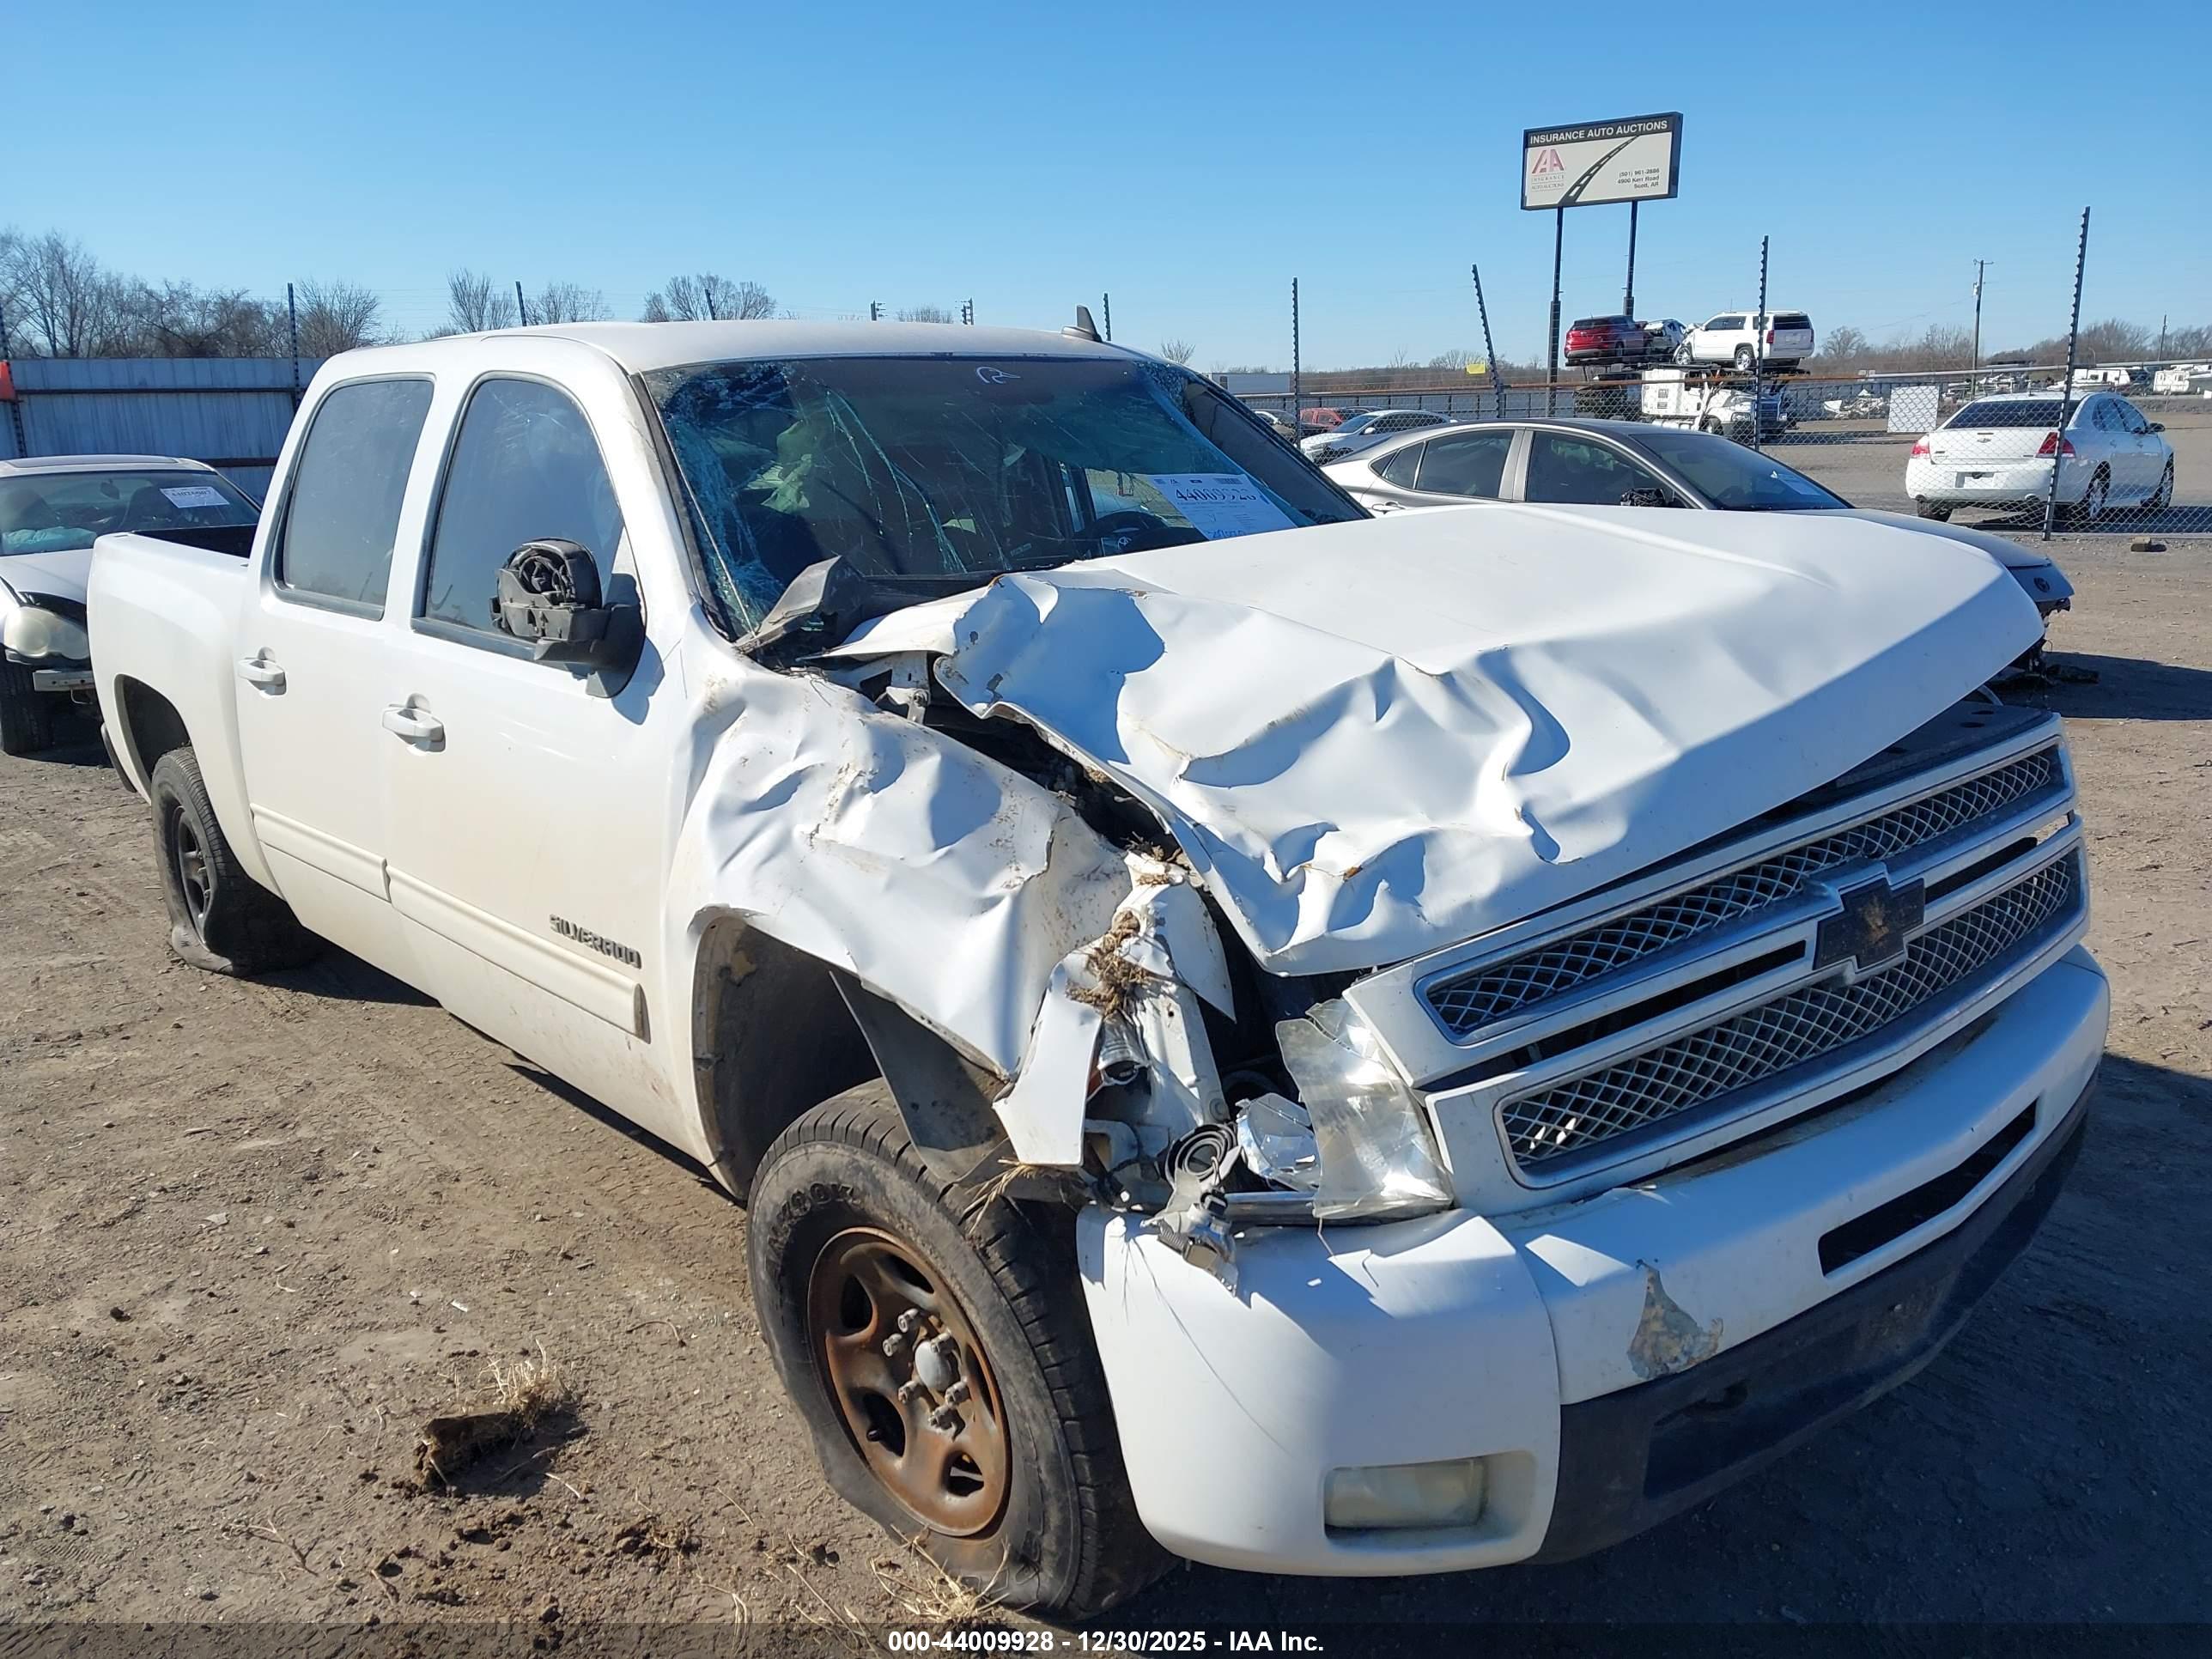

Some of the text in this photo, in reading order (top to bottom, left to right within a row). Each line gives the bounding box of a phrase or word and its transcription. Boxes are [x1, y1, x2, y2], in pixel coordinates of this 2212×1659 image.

[1529, 120, 1668, 144] INSURANCE AUTO AUCTIONS
[550, 914, 641, 969] SILVERADO
